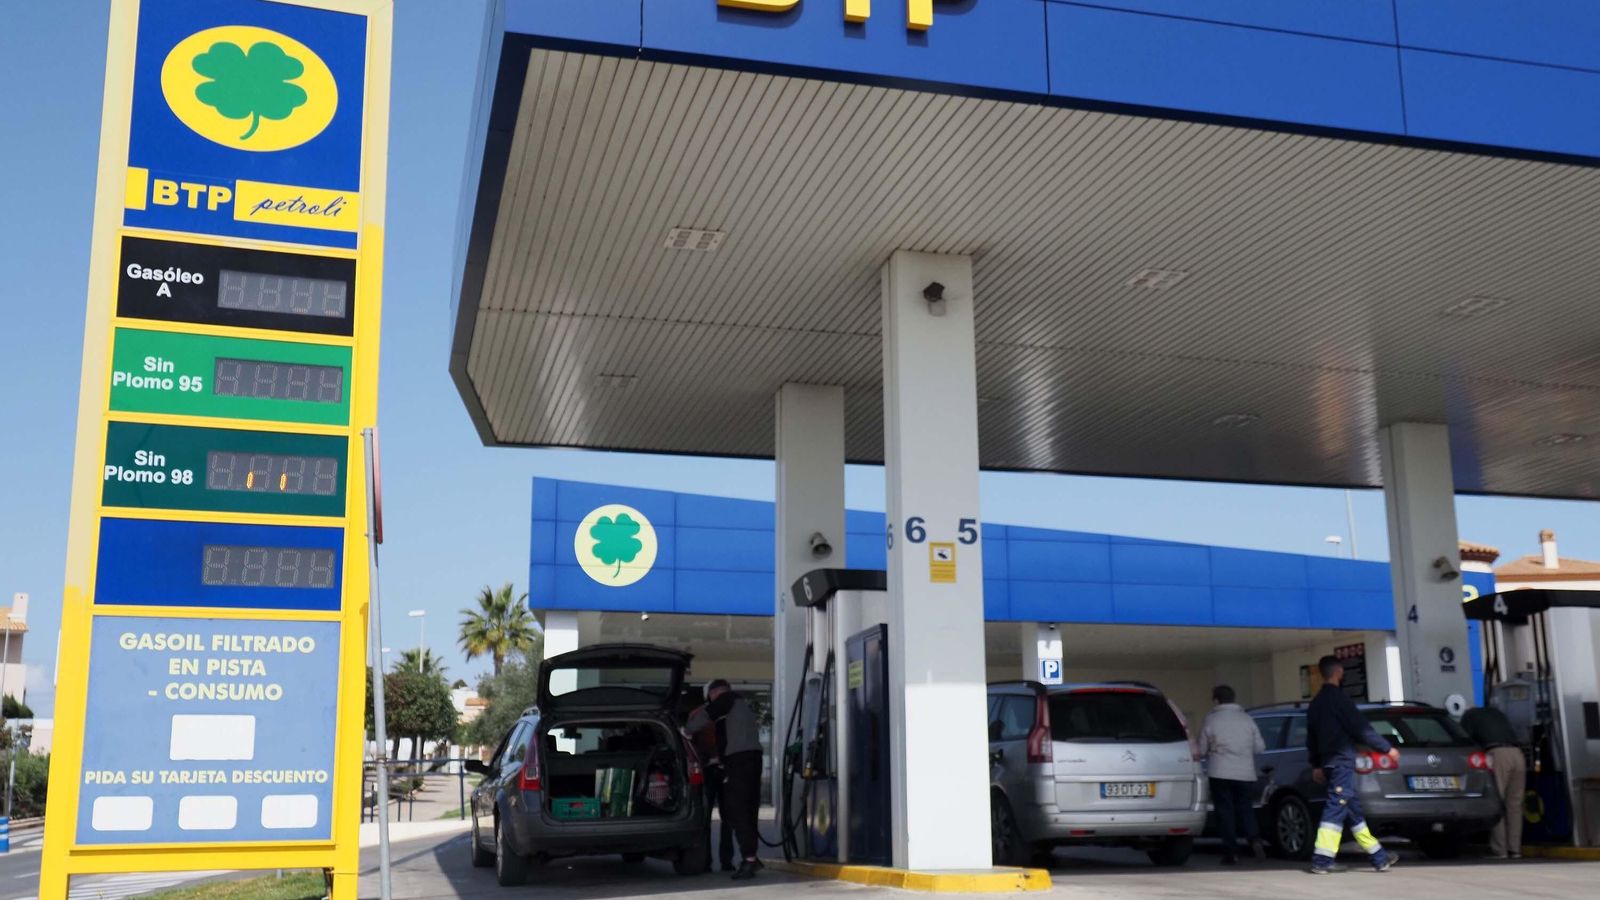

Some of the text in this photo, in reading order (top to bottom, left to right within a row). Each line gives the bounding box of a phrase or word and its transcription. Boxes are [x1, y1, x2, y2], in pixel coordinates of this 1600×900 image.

[152, 178, 232, 211] BTP
[250, 195, 347, 218] petroli
[126, 263, 204, 285] Gasóleo
[156, 282, 172, 298] A
[143, 356, 174, 373] Sin
[112, 371, 203, 393] Plomo 95
[134, 450, 166, 467] Sin
[104, 465, 194, 485] Plomo 98
[905, 516, 978, 545] 6 5
[803, 577, 813, 601] 6
[1408, 604, 1419, 624] 4
[1494, 593, 1508, 615] 4
[119, 632, 315, 653] GASOIL FILTRADO
[168, 658, 266, 677] EN PISTA
[1044, 661, 1058, 678] P
[165, 683, 283, 701] CONSUMO
[85, 769, 328, 785] PIDA SU TARJETA DESCUENTO
